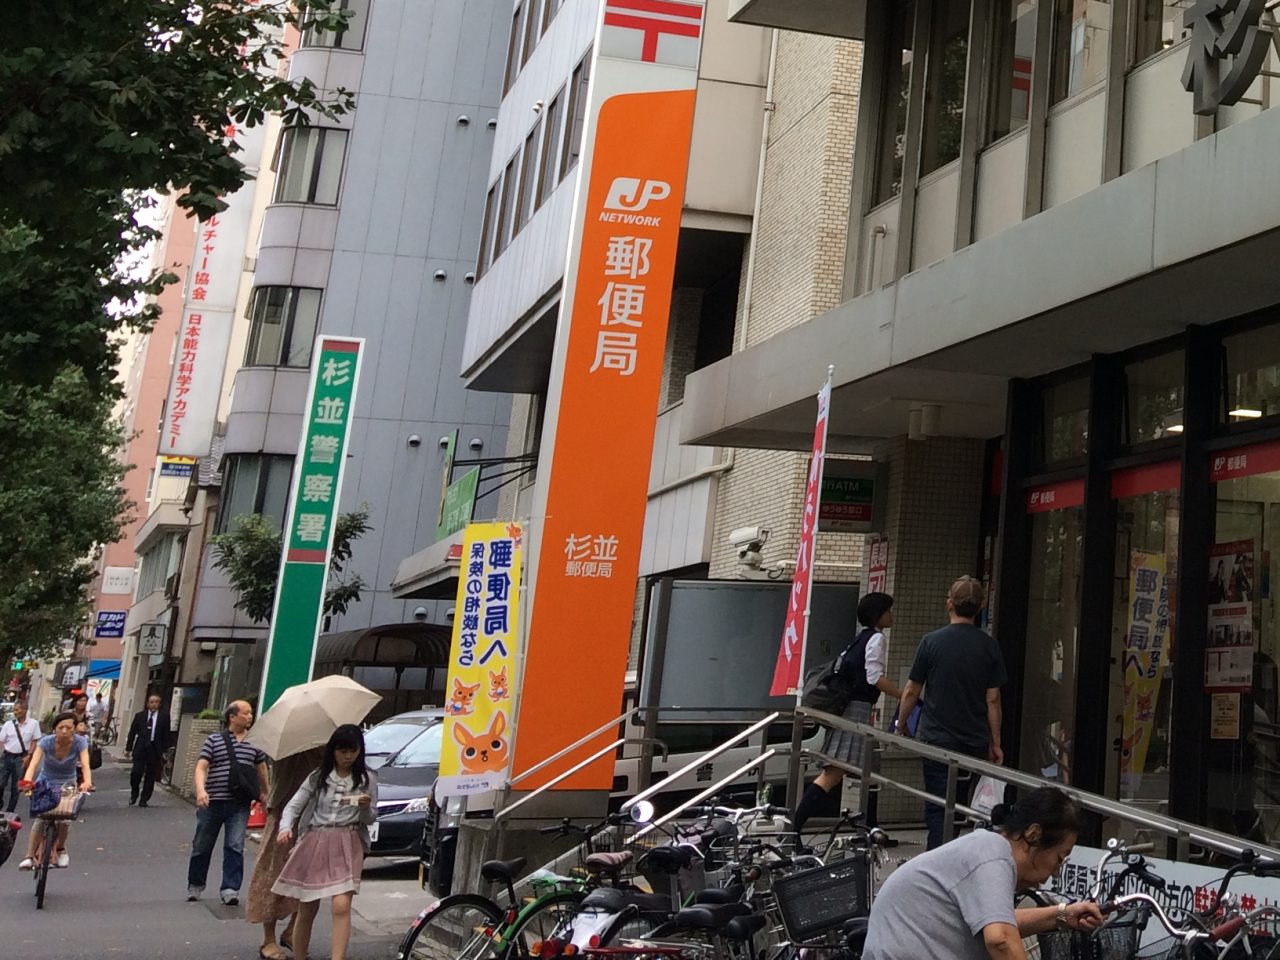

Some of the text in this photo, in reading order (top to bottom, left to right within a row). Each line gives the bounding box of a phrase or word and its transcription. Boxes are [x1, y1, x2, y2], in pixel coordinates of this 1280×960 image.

[599, 212, 662, 227] NETWORK
[590, 236, 653, 377] 郵便局
[169, 314, 203, 448] 日本能力科学アカデミー
[297, 357, 353, 544] 杉並警察署
[564, 533, 619, 561] 杉並
[564, 561, 613, 578] 郵便局
